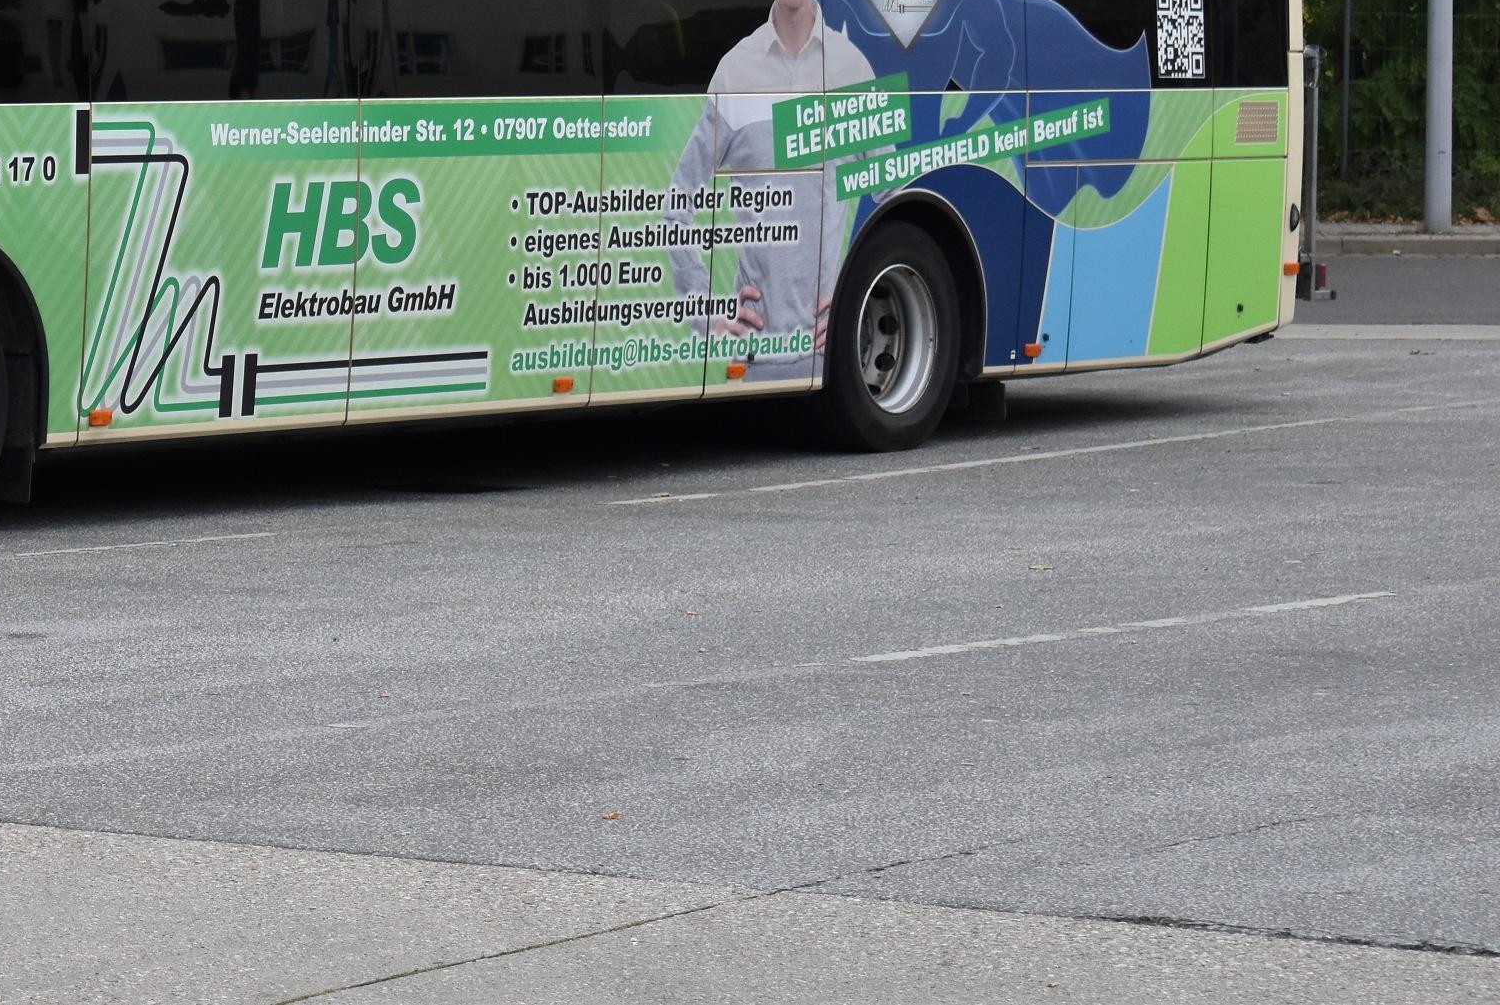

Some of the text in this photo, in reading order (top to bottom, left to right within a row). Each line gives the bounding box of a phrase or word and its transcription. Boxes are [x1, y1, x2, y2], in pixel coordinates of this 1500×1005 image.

[796, 86, 889, 128] Ich werde
[210, 116, 652, 146] Werner-Seelenbinder Str. 12 07907 Oettersdorf
[786, 108, 907, 159] ELEKTRIKER
[843, 105, 1105, 193] weil SUPERHELD kein Beruf ist
[8, 156, 35, 181] 17
[43, 156, 56, 181] 0
[526, 185, 793, 215] TOP-Ausbilder in der Region
[261, 178, 421, 269] HBS
[524, 221, 799, 258] eigenes Ausbildungszentrum
[522, 261, 662, 289] bis 1.000 Euro
[258, 284, 456, 320] Elektrobau GmbH
[523, 295, 738, 326] Ausbildungsvergütung
[511, 329, 812, 372] ausbildung@hbs-elektrobau.de
